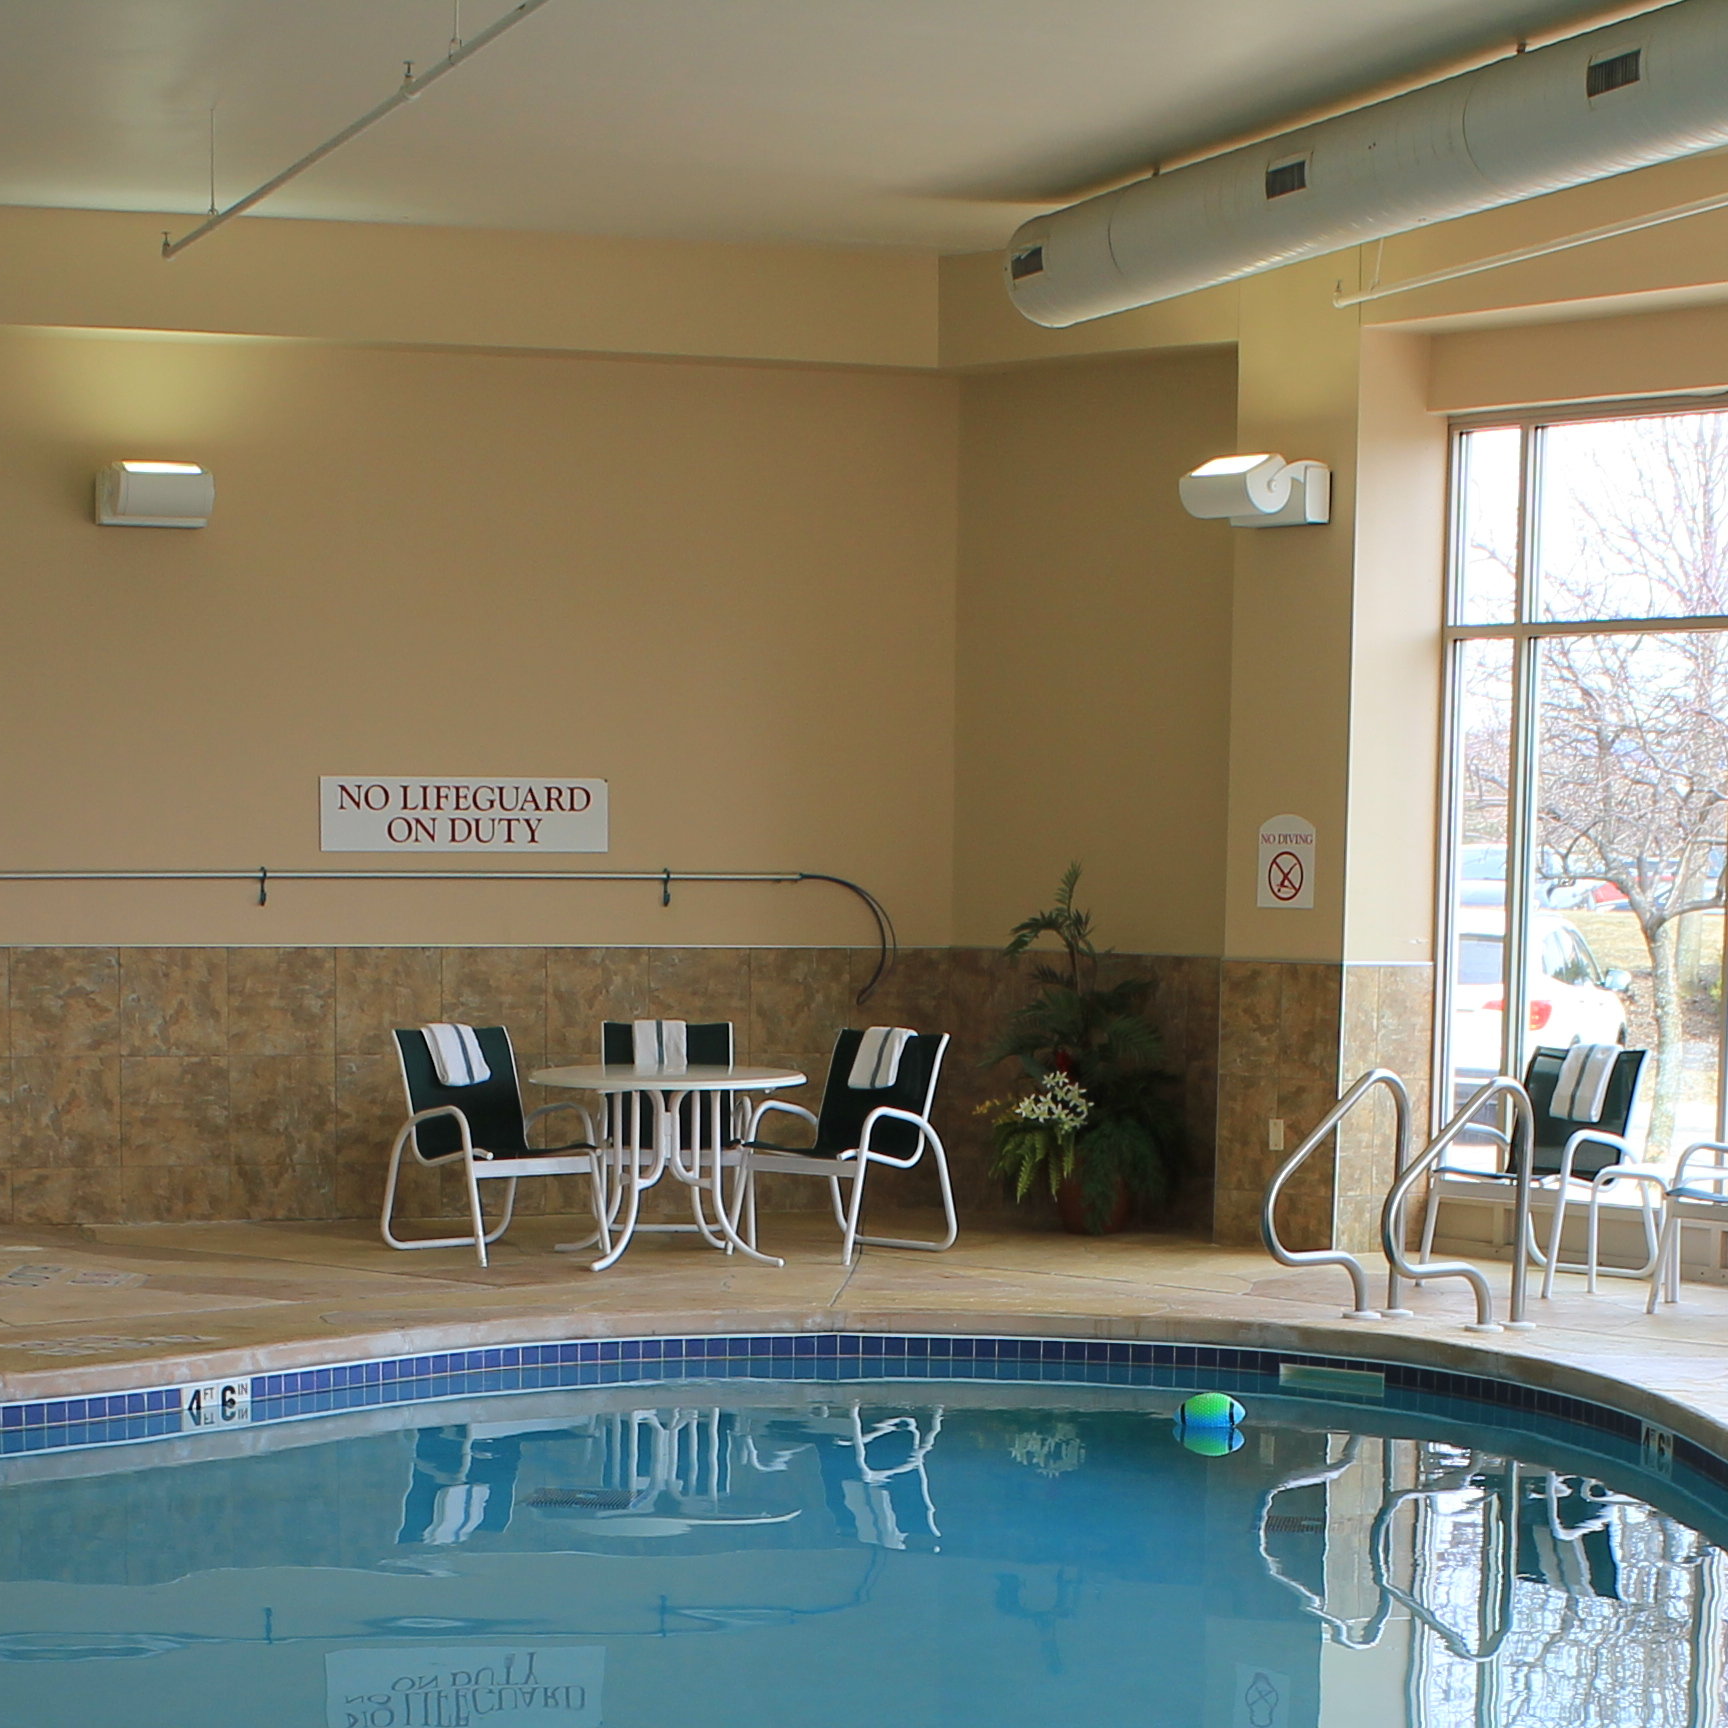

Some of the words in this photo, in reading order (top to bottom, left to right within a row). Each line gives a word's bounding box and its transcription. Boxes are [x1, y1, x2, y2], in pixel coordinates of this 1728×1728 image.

[337, 785, 389, 810] NO
[400, 785, 591, 812] LIFEGUARD
[387, 817, 436, 843] ON
[449, 818, 542, 844] DUTY
[1261, 834, 1276, 844] NO
[1278, 834, 1313, 845] DIVING
[203, 1387, 215, 1400] FT
[221, 1385, 236, 1407] 6
[238, 1383, 248, 1396] IN
